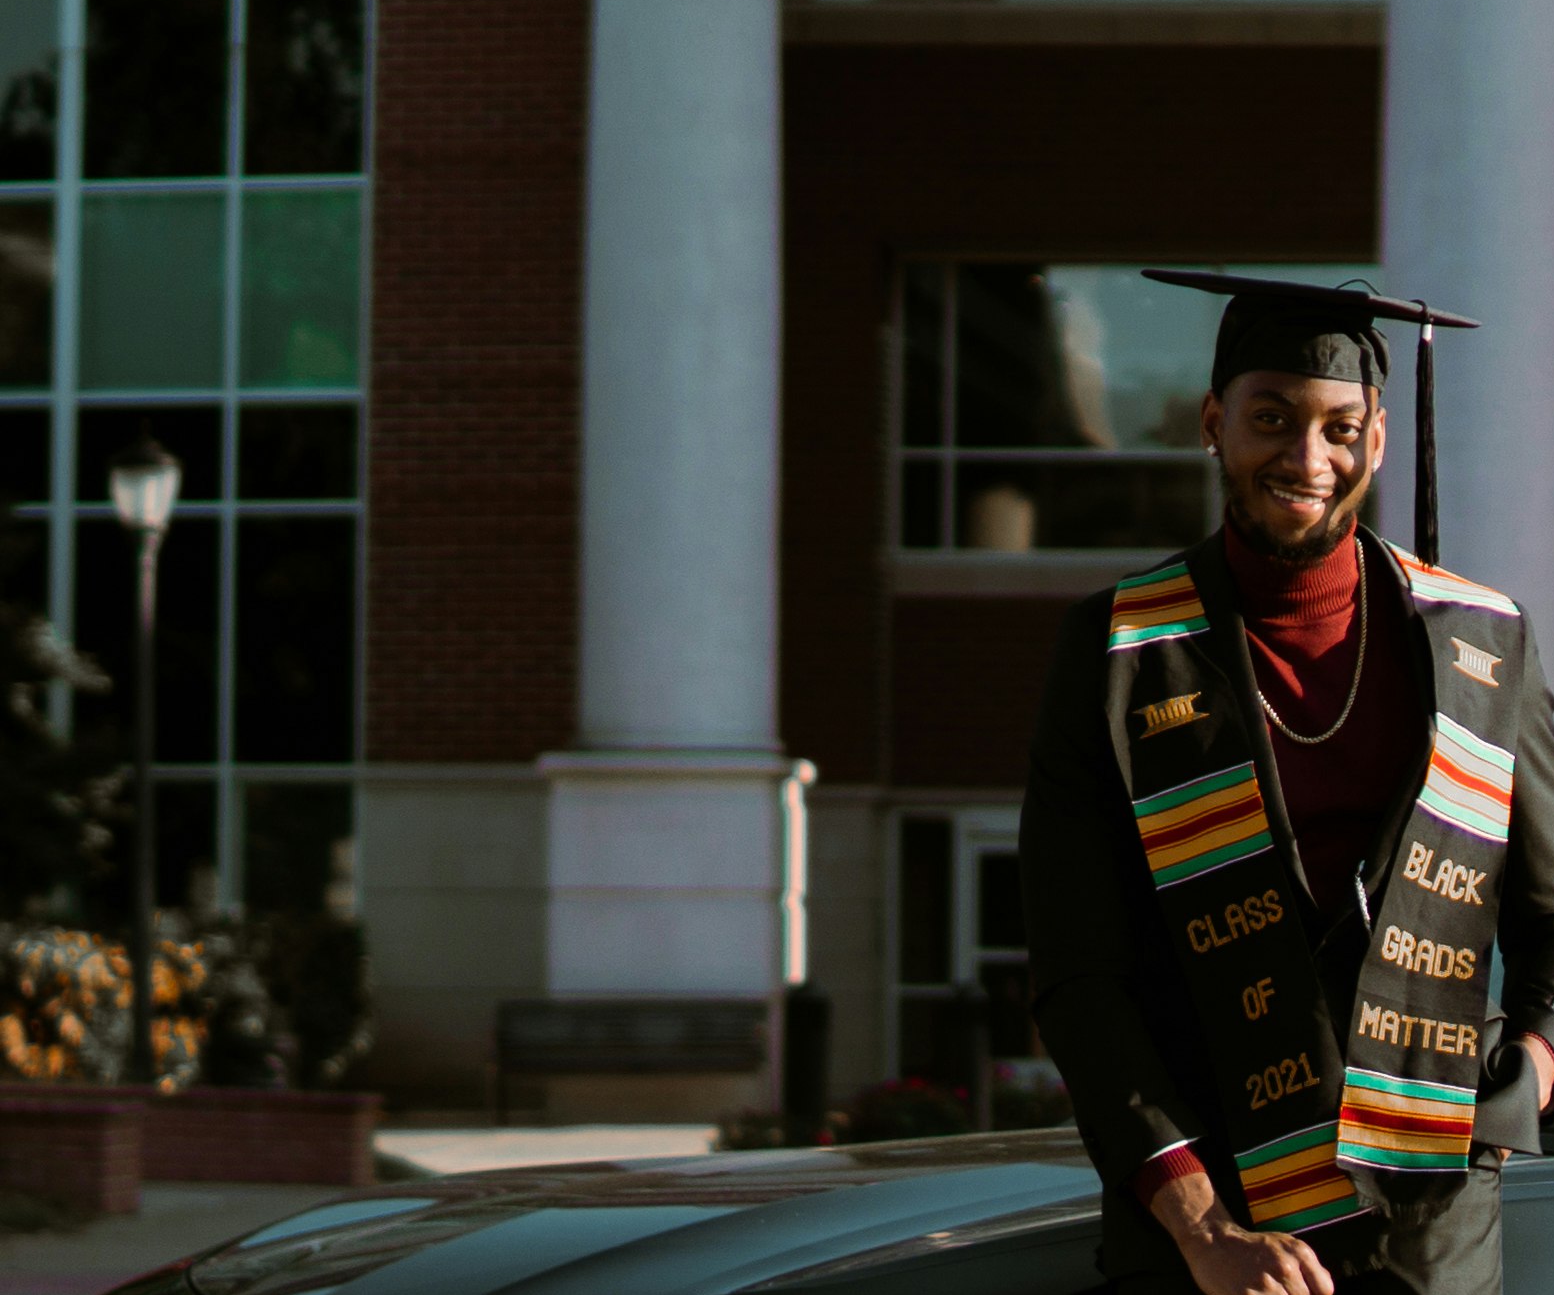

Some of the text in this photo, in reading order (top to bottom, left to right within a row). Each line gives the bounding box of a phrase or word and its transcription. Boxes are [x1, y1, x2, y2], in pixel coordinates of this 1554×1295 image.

[1402, 840, 1488, 907] BLACK
[1186, 889, 1284, 954] CLASS
[1381, 923, 1476, 980] GRADS
[1243, 977, 1276, 1022] OF
[1357, 1001, 1478, 1057] MATTER
[1245, 1052, 1320, 1111] 2021
